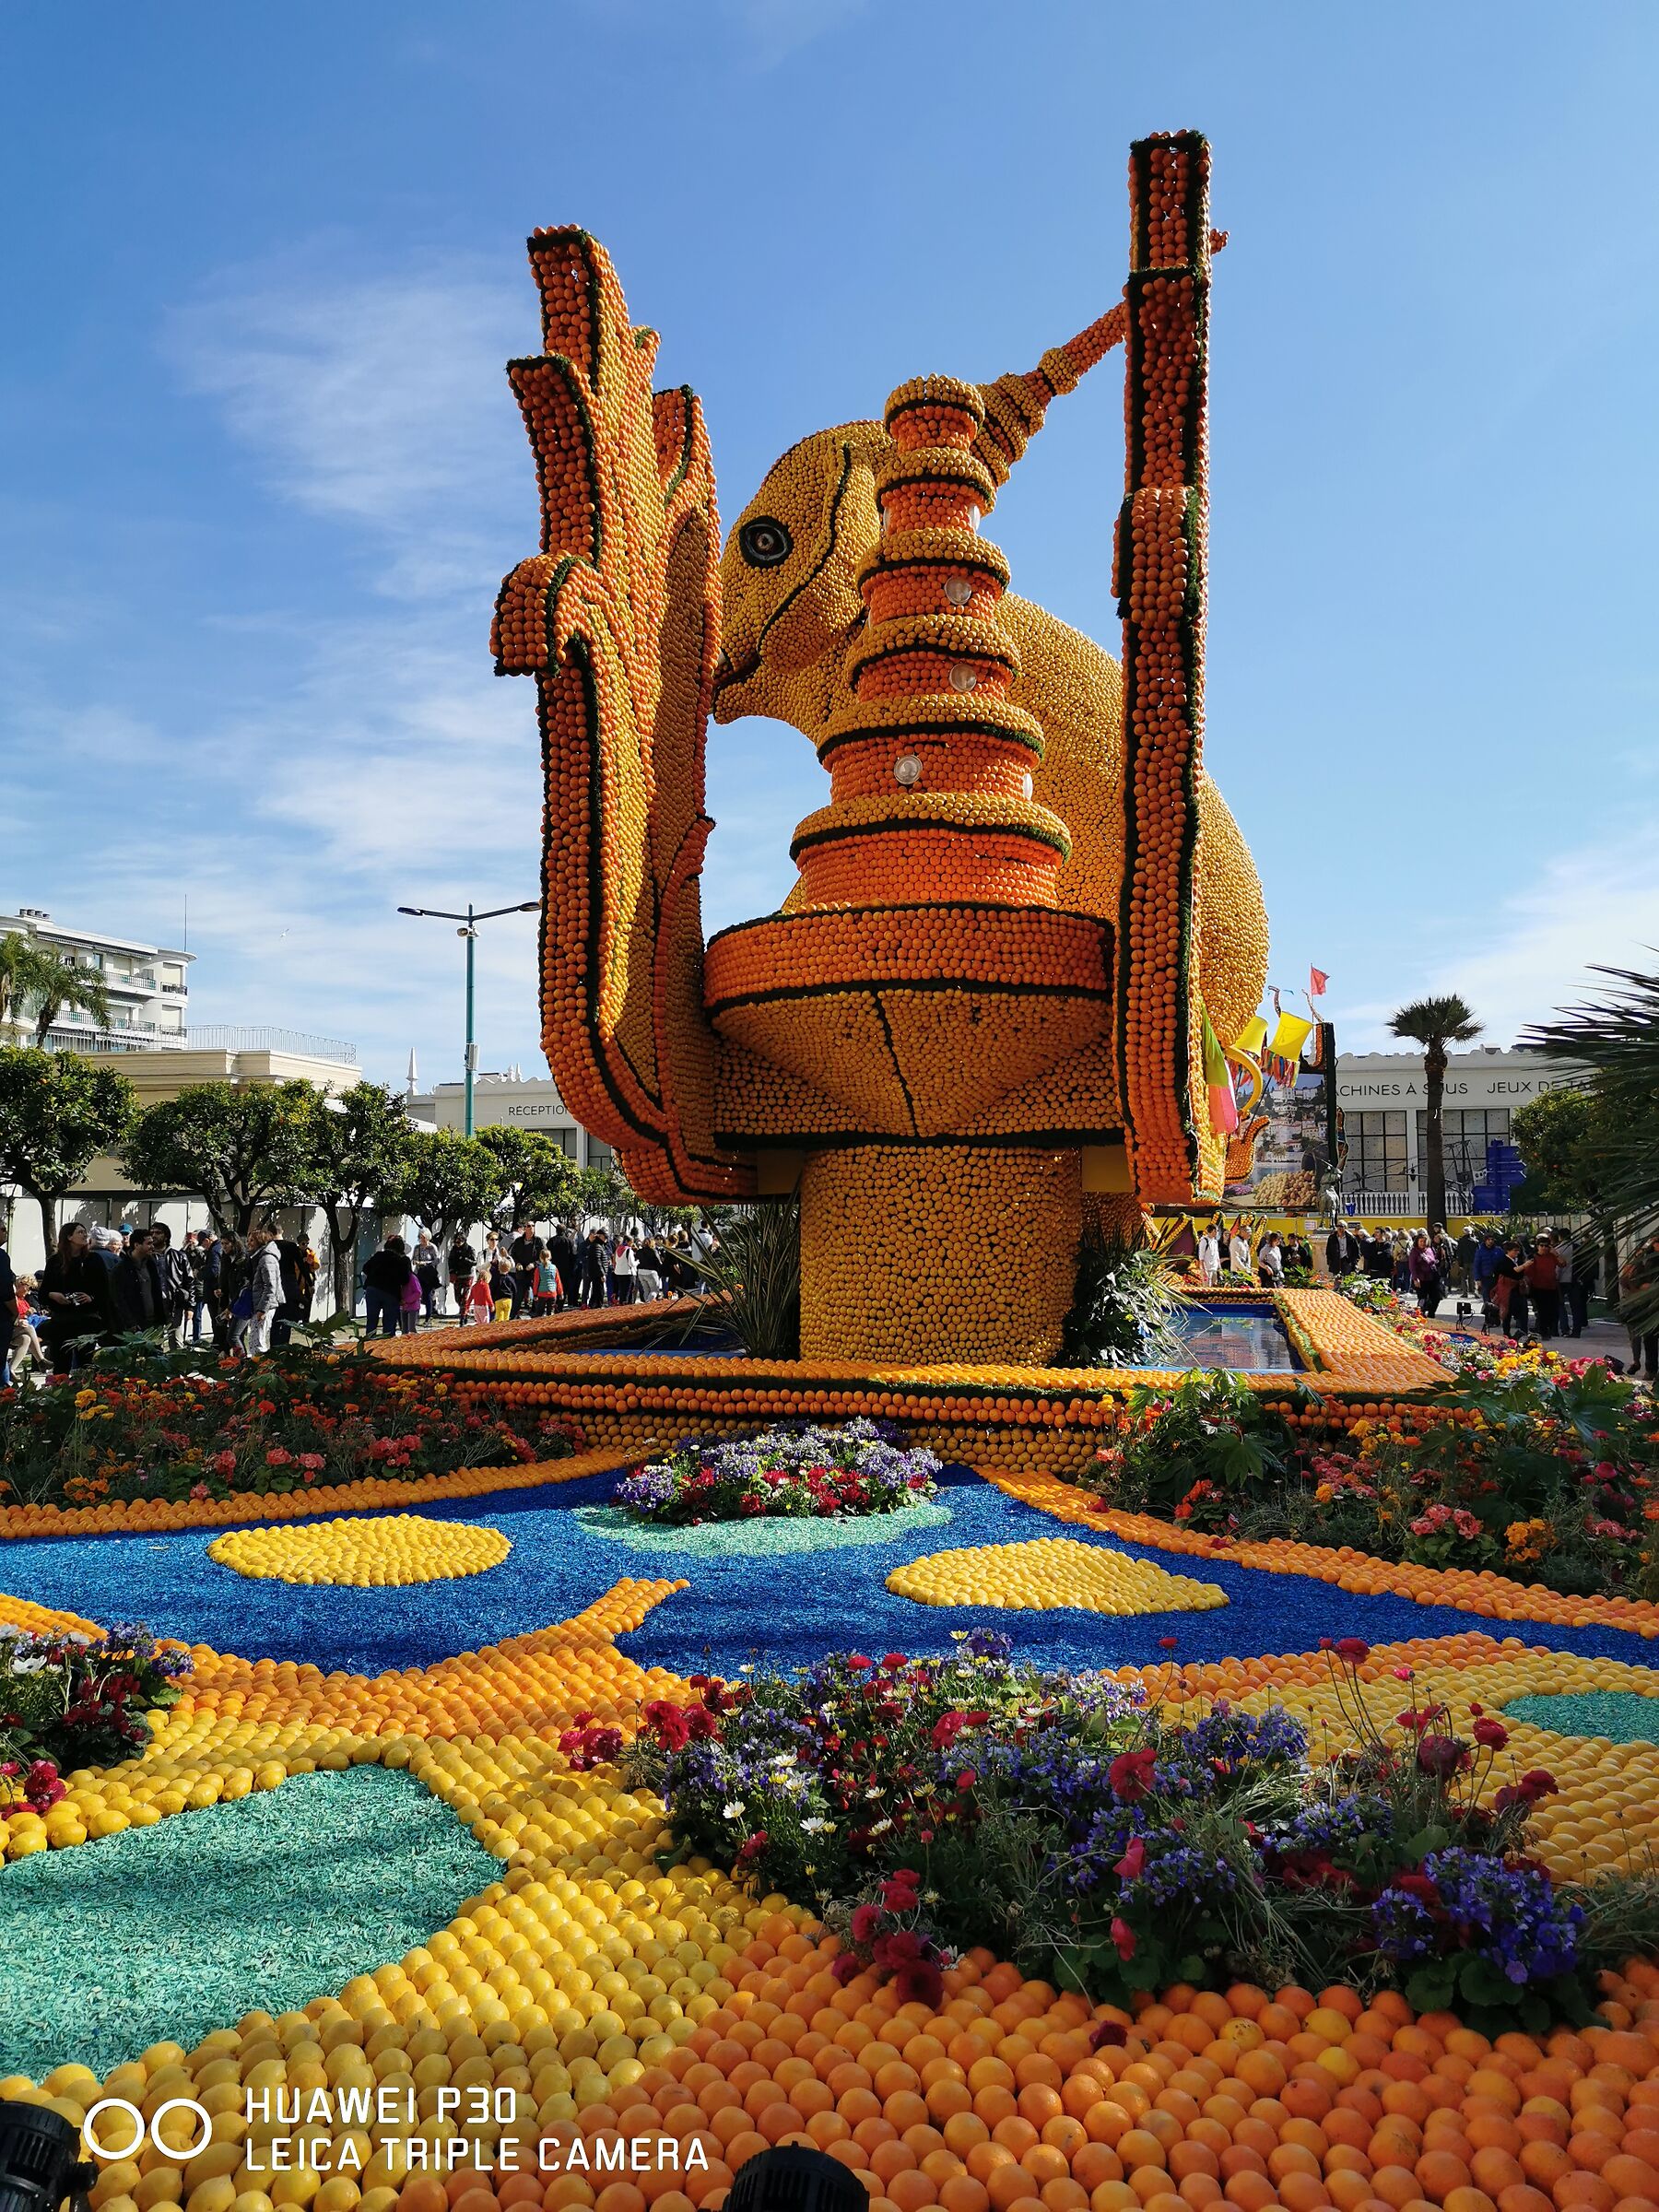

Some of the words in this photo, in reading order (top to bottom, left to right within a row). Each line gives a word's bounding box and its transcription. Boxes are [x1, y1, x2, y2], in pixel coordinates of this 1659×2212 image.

[1335, 1084, 1401, 1097] CHINES
[1406, 1082, 1418, 1096] À
[1422, 1082, 1468, 1095] SUS
[1487, 1081, 1533, 1094] JEUX
[508, 1104, 568, 1116] RÉCEPTIO
